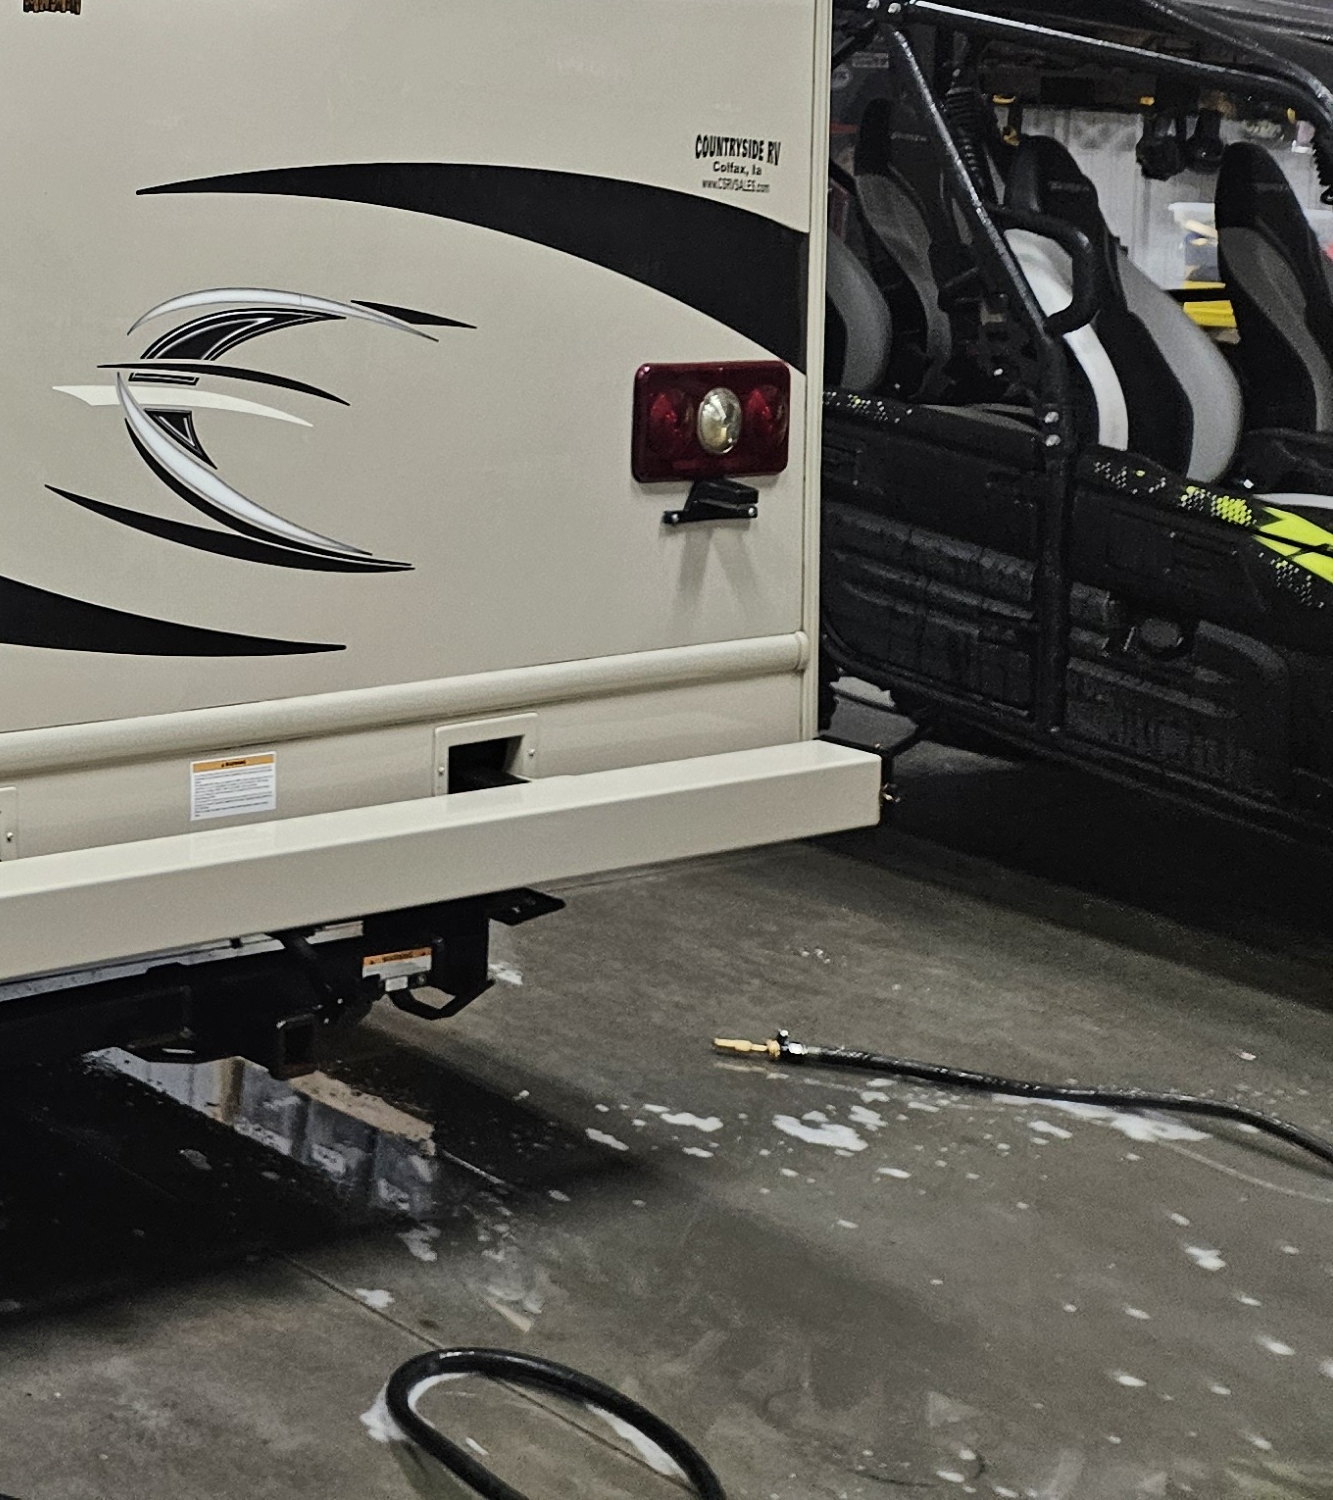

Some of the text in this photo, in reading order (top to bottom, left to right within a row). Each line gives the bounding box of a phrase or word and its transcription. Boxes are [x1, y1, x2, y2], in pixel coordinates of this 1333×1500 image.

[695, 133, 781, 166] COUNTRYSIDE RV
[713, 160, 749, 176] Colfax,
